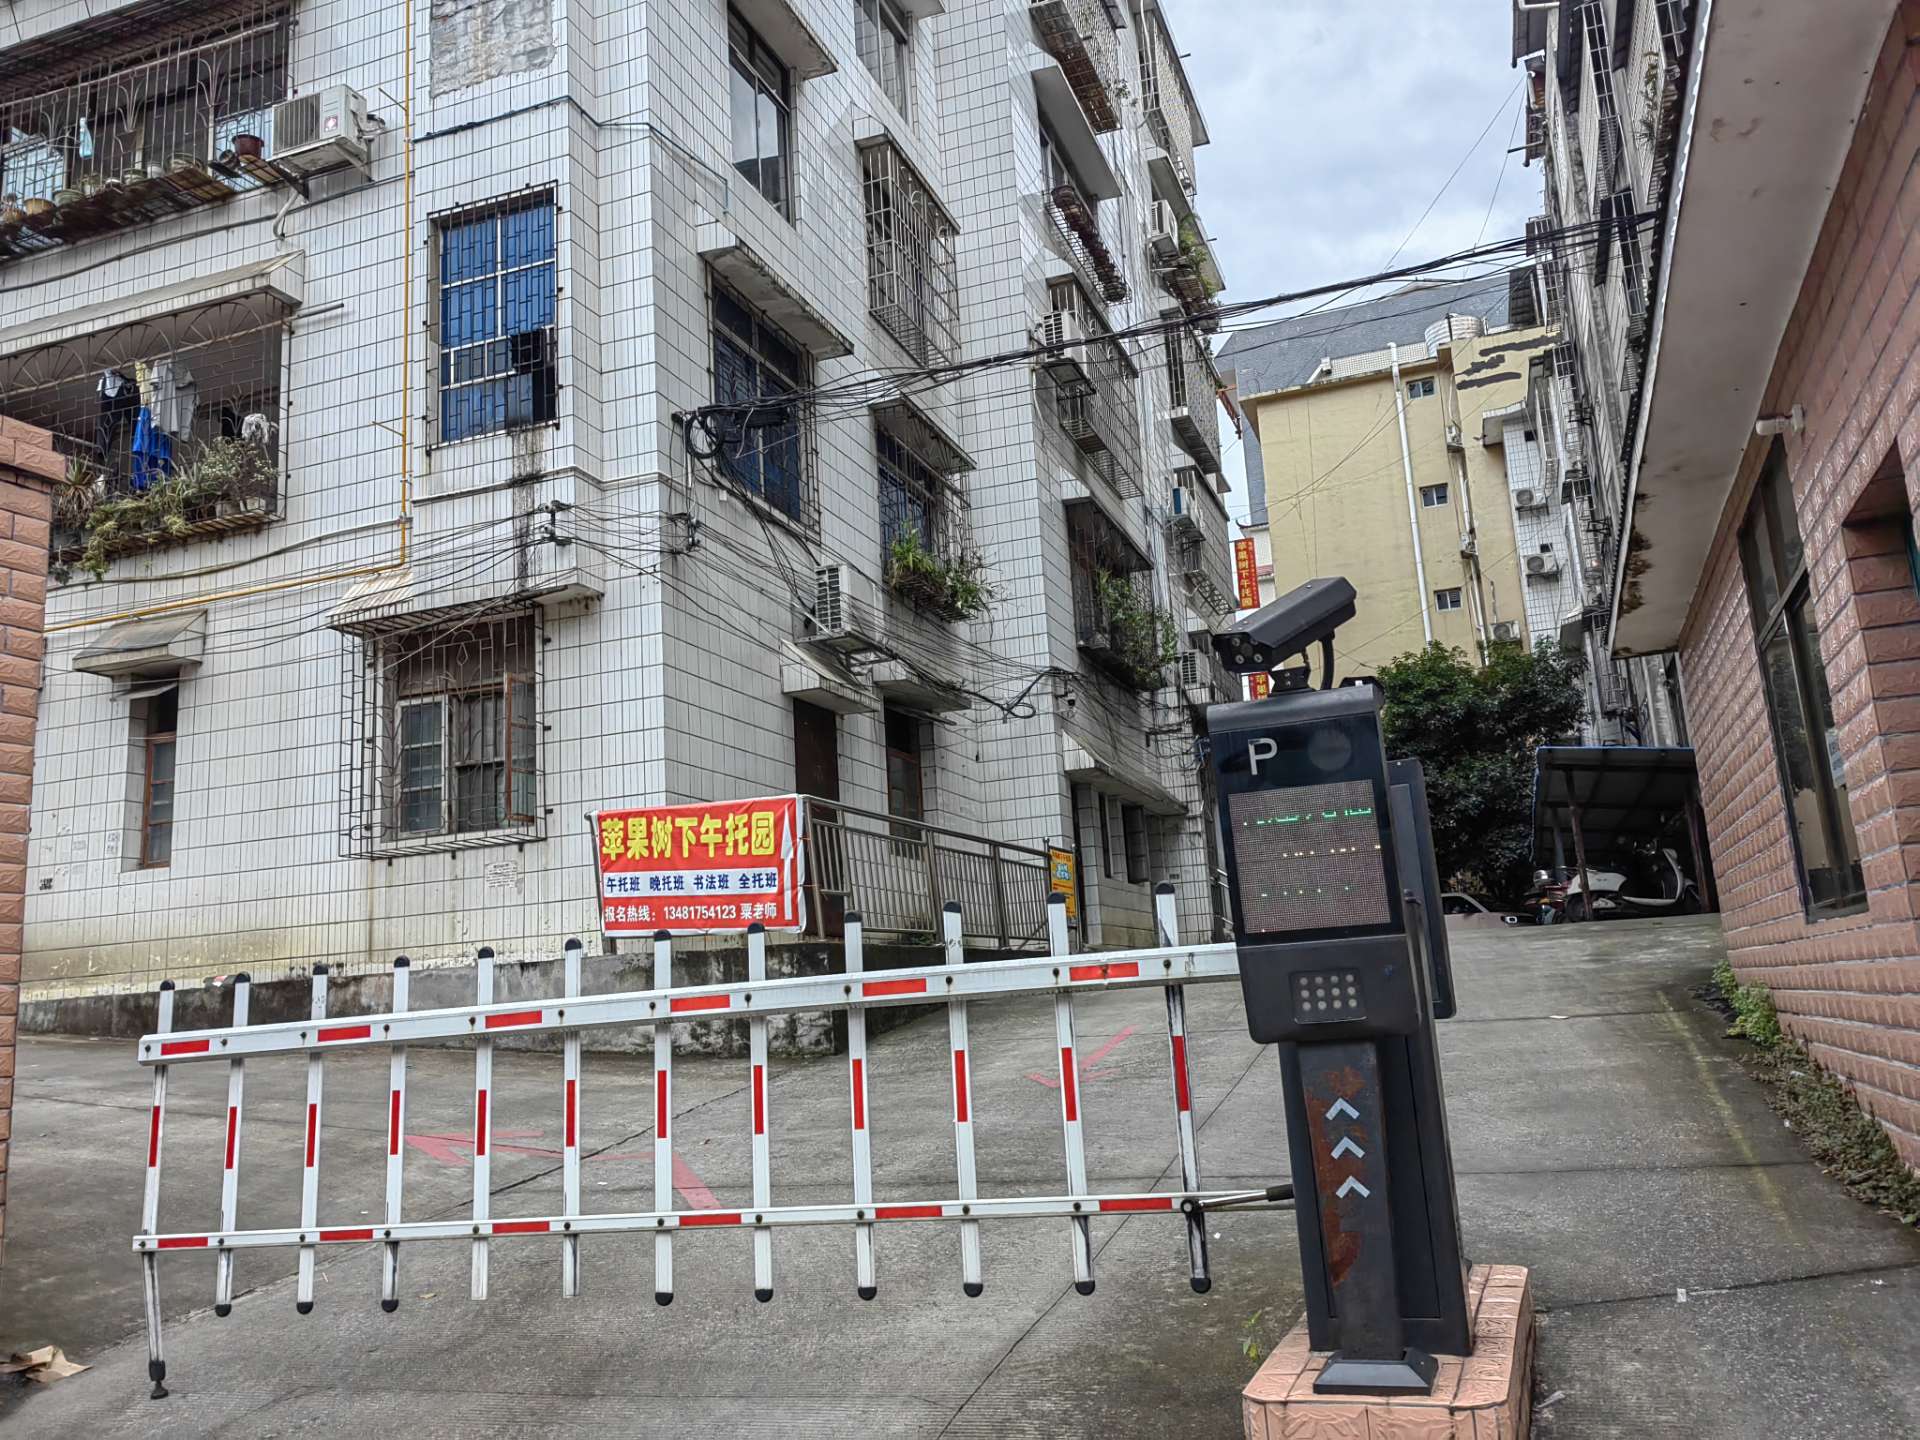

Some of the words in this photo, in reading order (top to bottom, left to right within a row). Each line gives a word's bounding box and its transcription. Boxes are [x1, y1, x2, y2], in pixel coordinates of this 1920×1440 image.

[1247, 737, 1278, 776] P
[601, 811, 775, 861] 苹果树下午托园
[606, 877, 641, 893] 午托班
[649, 875, 685, 892] 晚托班
[693, 874, 730, 890] 书法班
[738, 872, 778, 889] 全托班
[663, 905, 737, 919] 13481754123
